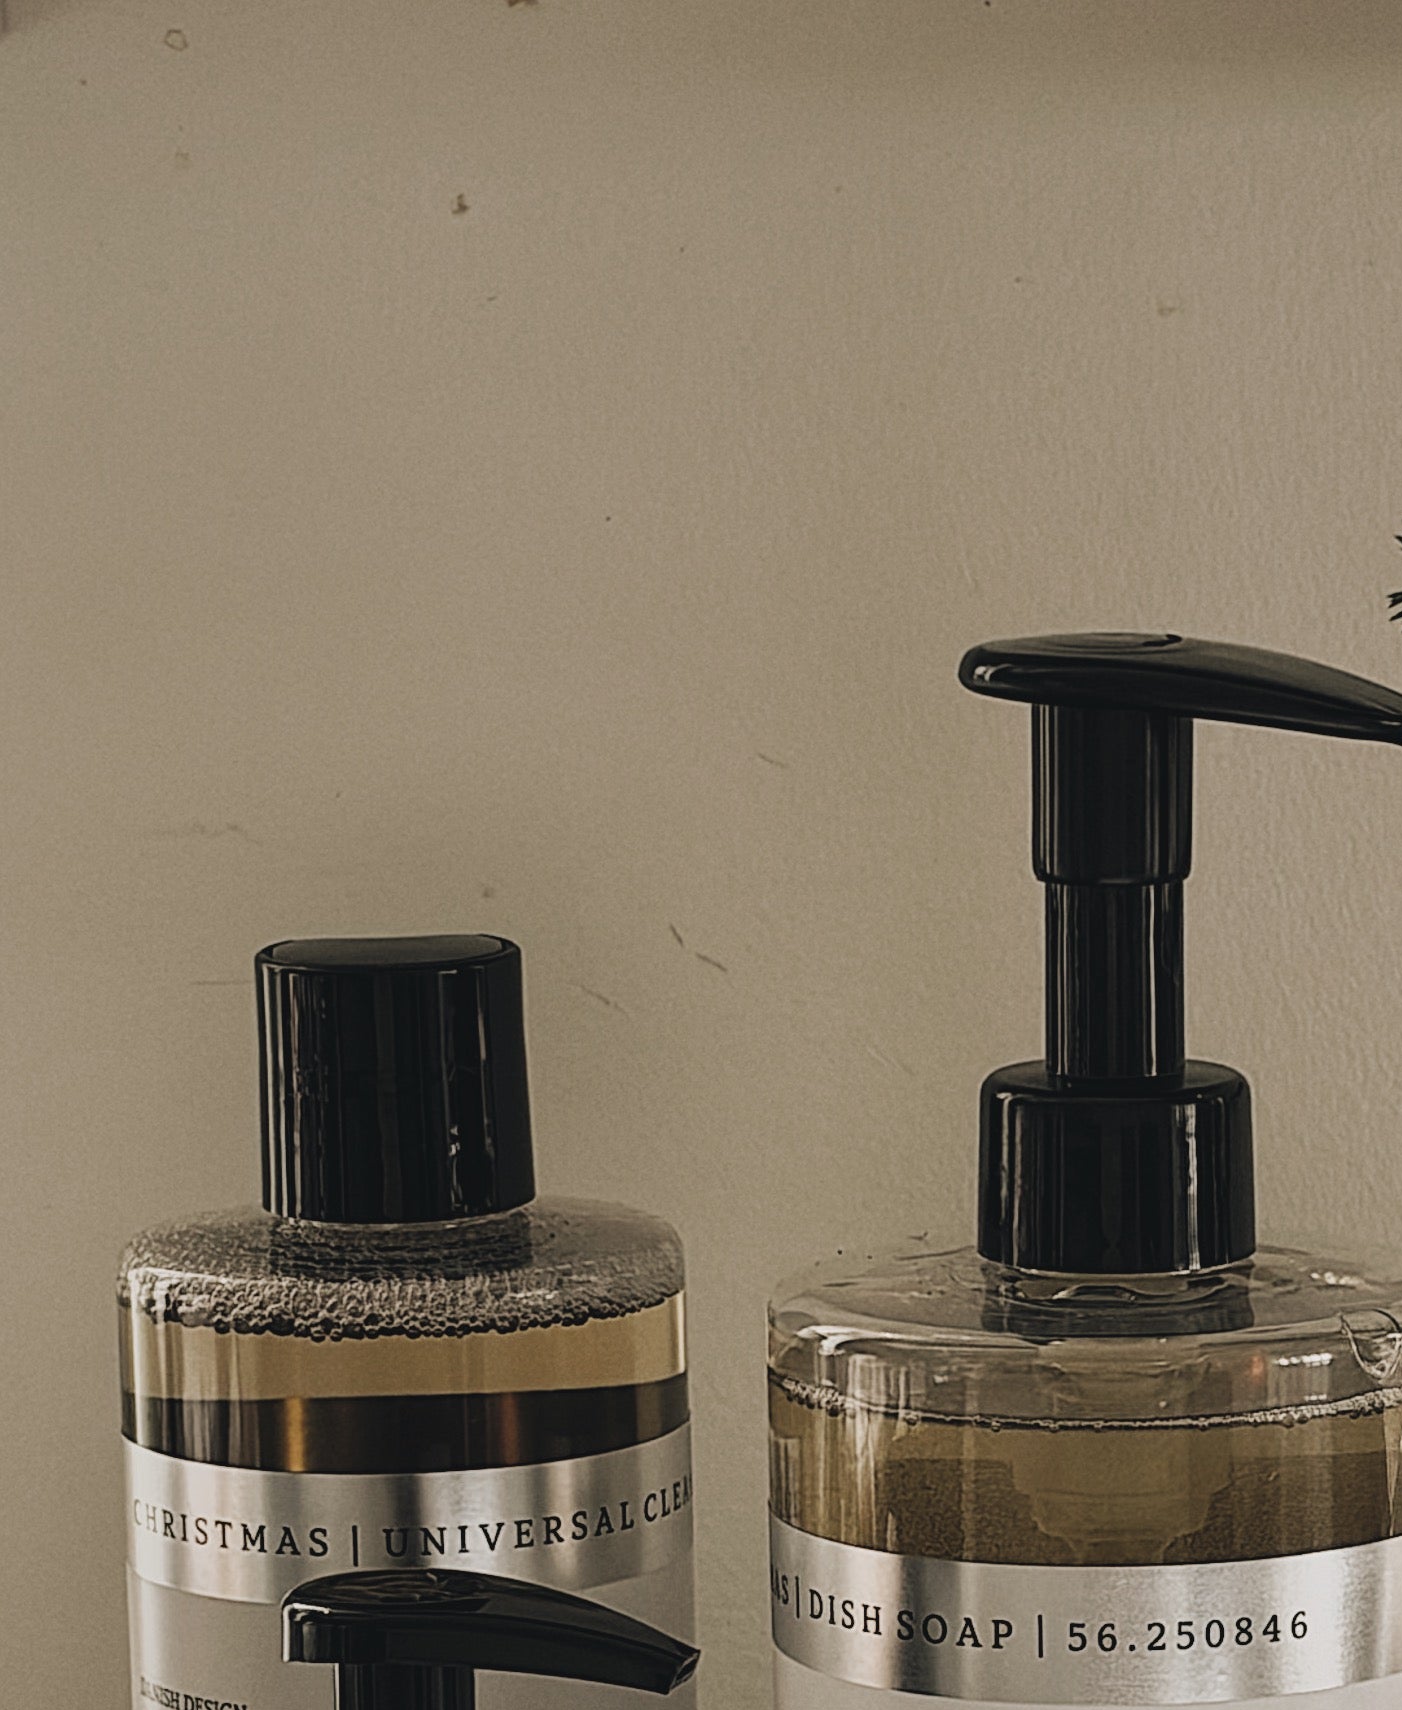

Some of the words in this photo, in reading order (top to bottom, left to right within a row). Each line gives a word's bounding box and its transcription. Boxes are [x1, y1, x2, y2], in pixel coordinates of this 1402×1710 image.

[133, 1498, 330, 1557] CHRISTMAS
[382, 1500, 636, 1558] UNIVERSAL
[642, 1473, 693, 1523] CLEA
[808, 1588, 882, 1635] DISH
[895, 1609, 1014, 1650] SOAP
[1066, 1610, 1309, 1653] 56.250846
